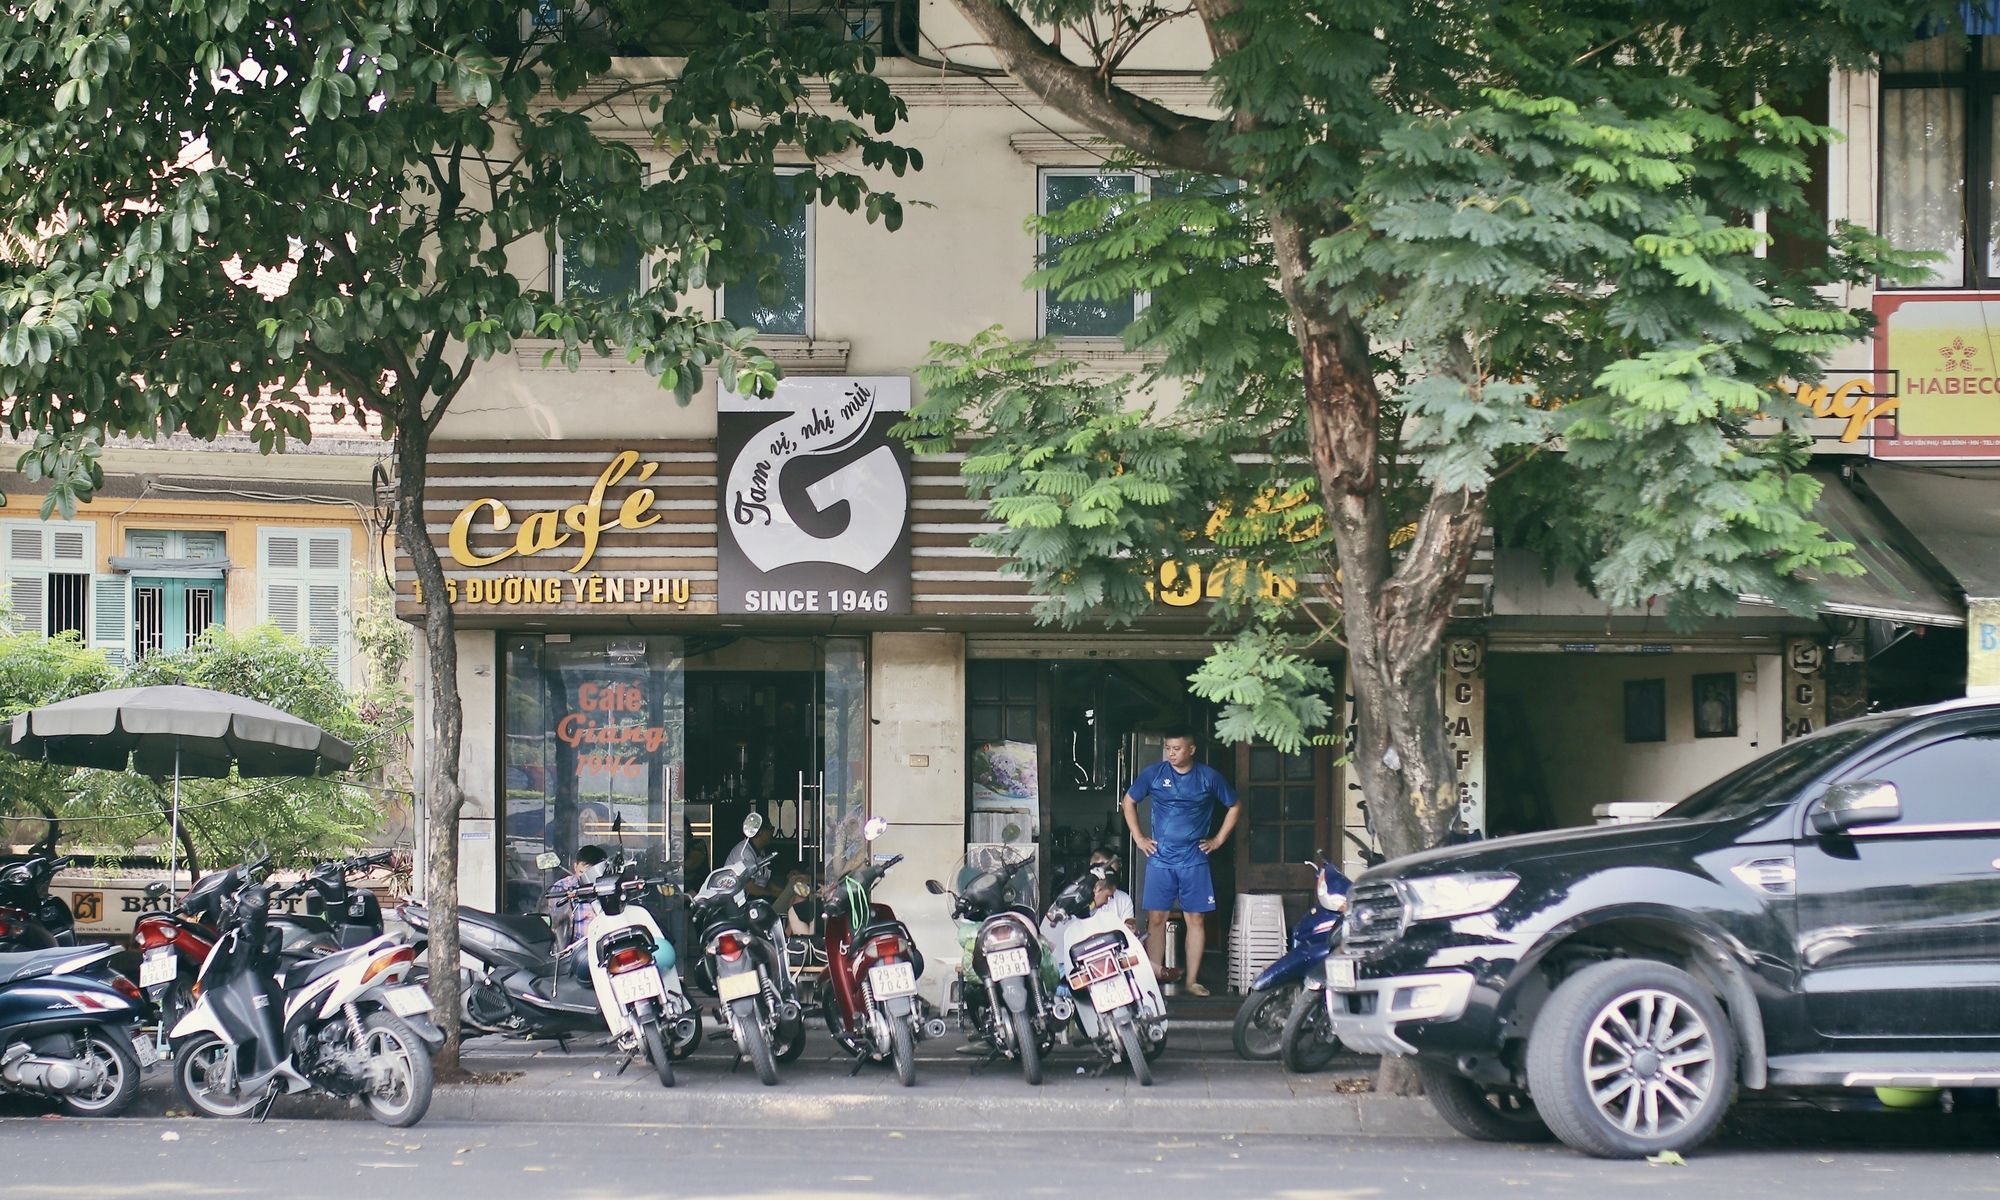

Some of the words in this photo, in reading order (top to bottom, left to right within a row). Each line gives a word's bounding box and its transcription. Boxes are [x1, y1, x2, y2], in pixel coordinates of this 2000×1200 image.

[734, 460, 771, 525] Tam
[801, 408, 835, 439] nhị
[841, 382, 871, 420] mùi
[448, 450, 662, 574] Café
[412, 578, 458, 604] 16
[572, 571, 625, 603] YÊN
[633, 577, 690, 610] PHỤ
[744, 590, 819, 612] SINCE
[828, 590, 889, 612] 1946
[1796, 684, 1815, 738] CA
